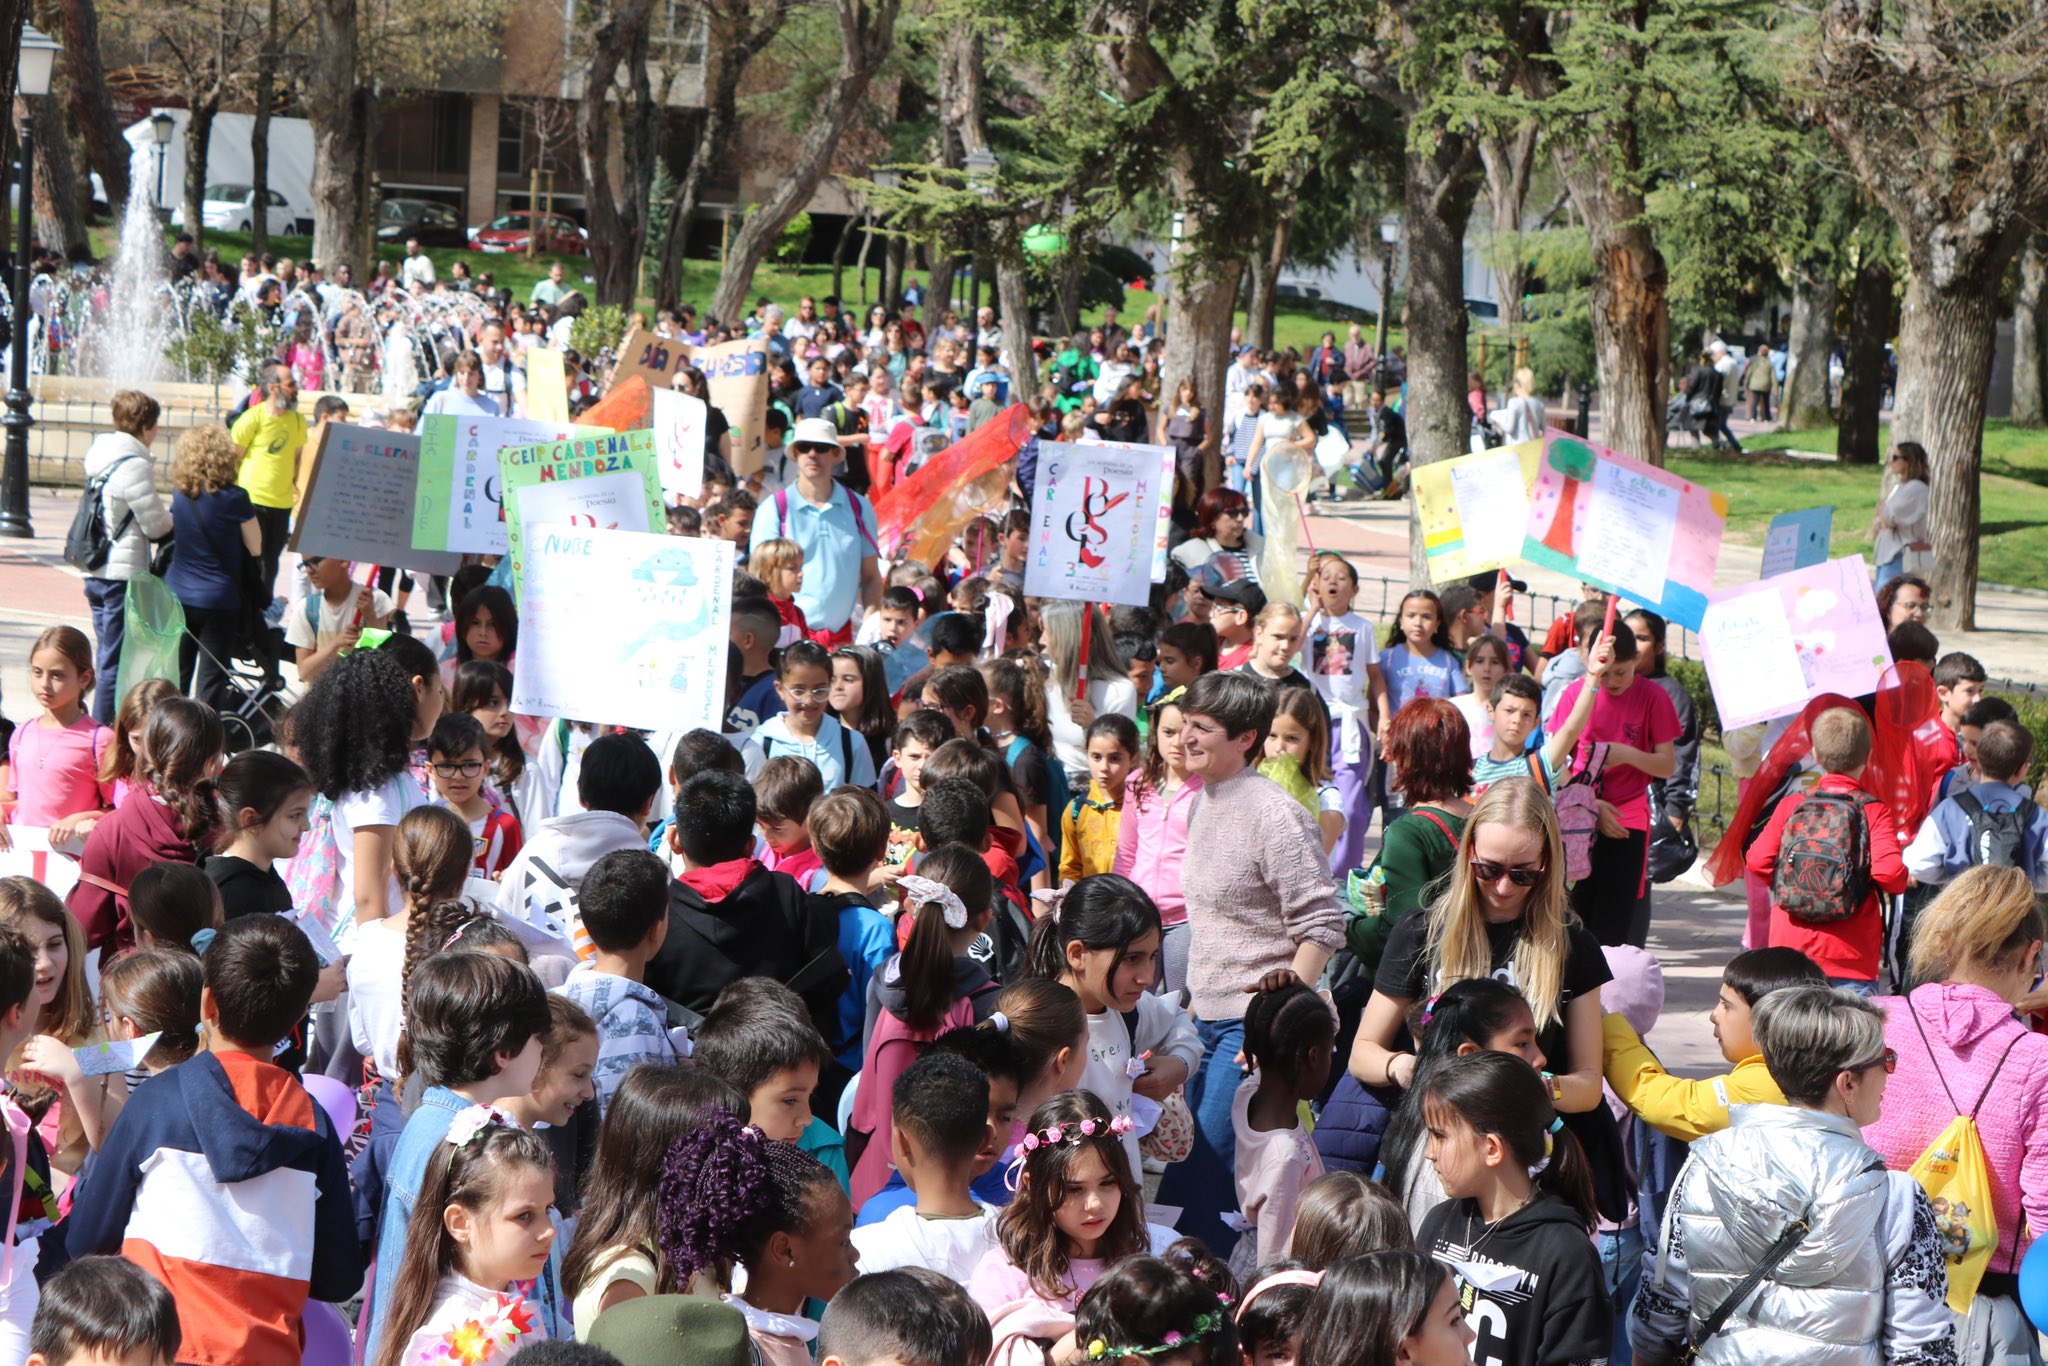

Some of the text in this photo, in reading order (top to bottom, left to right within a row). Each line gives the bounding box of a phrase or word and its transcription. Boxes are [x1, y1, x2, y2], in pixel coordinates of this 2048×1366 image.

[463, 425, 480, 530] CARDENAL
[509, 433, 643, 466] CEIP CARDENAL
[540, 455, 633, 483] MENDOZA
[544, 533, 594, 557] NUBE
[1038, 463, 1059, 568] CARENAL
[1156, 460, 1174, 564] MNDOZA
